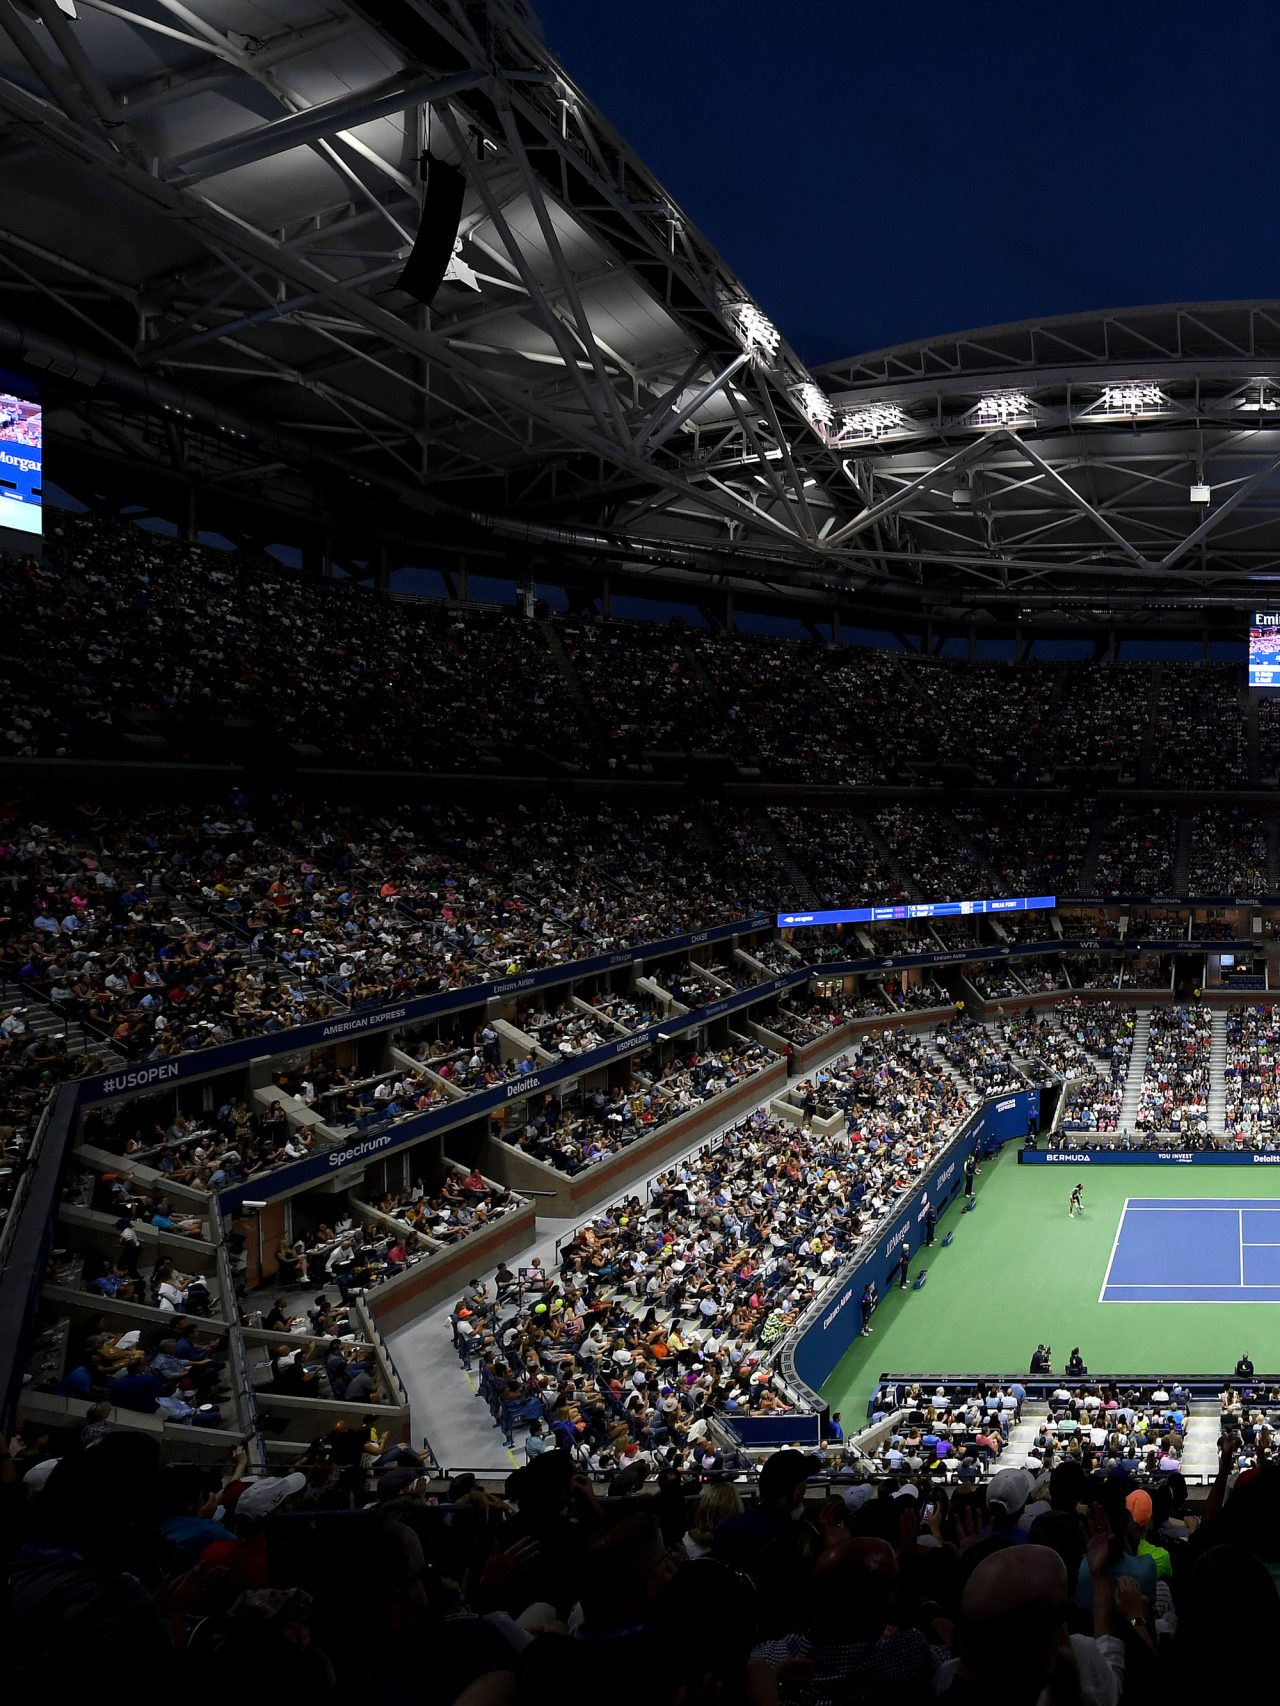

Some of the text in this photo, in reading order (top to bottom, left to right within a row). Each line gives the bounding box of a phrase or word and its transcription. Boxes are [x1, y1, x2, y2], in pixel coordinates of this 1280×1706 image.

[1080, 941, 1100, 949] WTA
[493, 976, 535, 994] Emirates Airline
[322, 1008, 406, 1037] AMERICAN EXPRESS
[616, 1033, 650, 1052] USOPEN.ORG
[103, 1062, 179, 1094] #USOPEN
[506, 1076, 541, 1097] Deloitte.
[328, 1135, 391, 1167] Spectrum
[1046, 1154, 1091, 1162] BERMUDA
